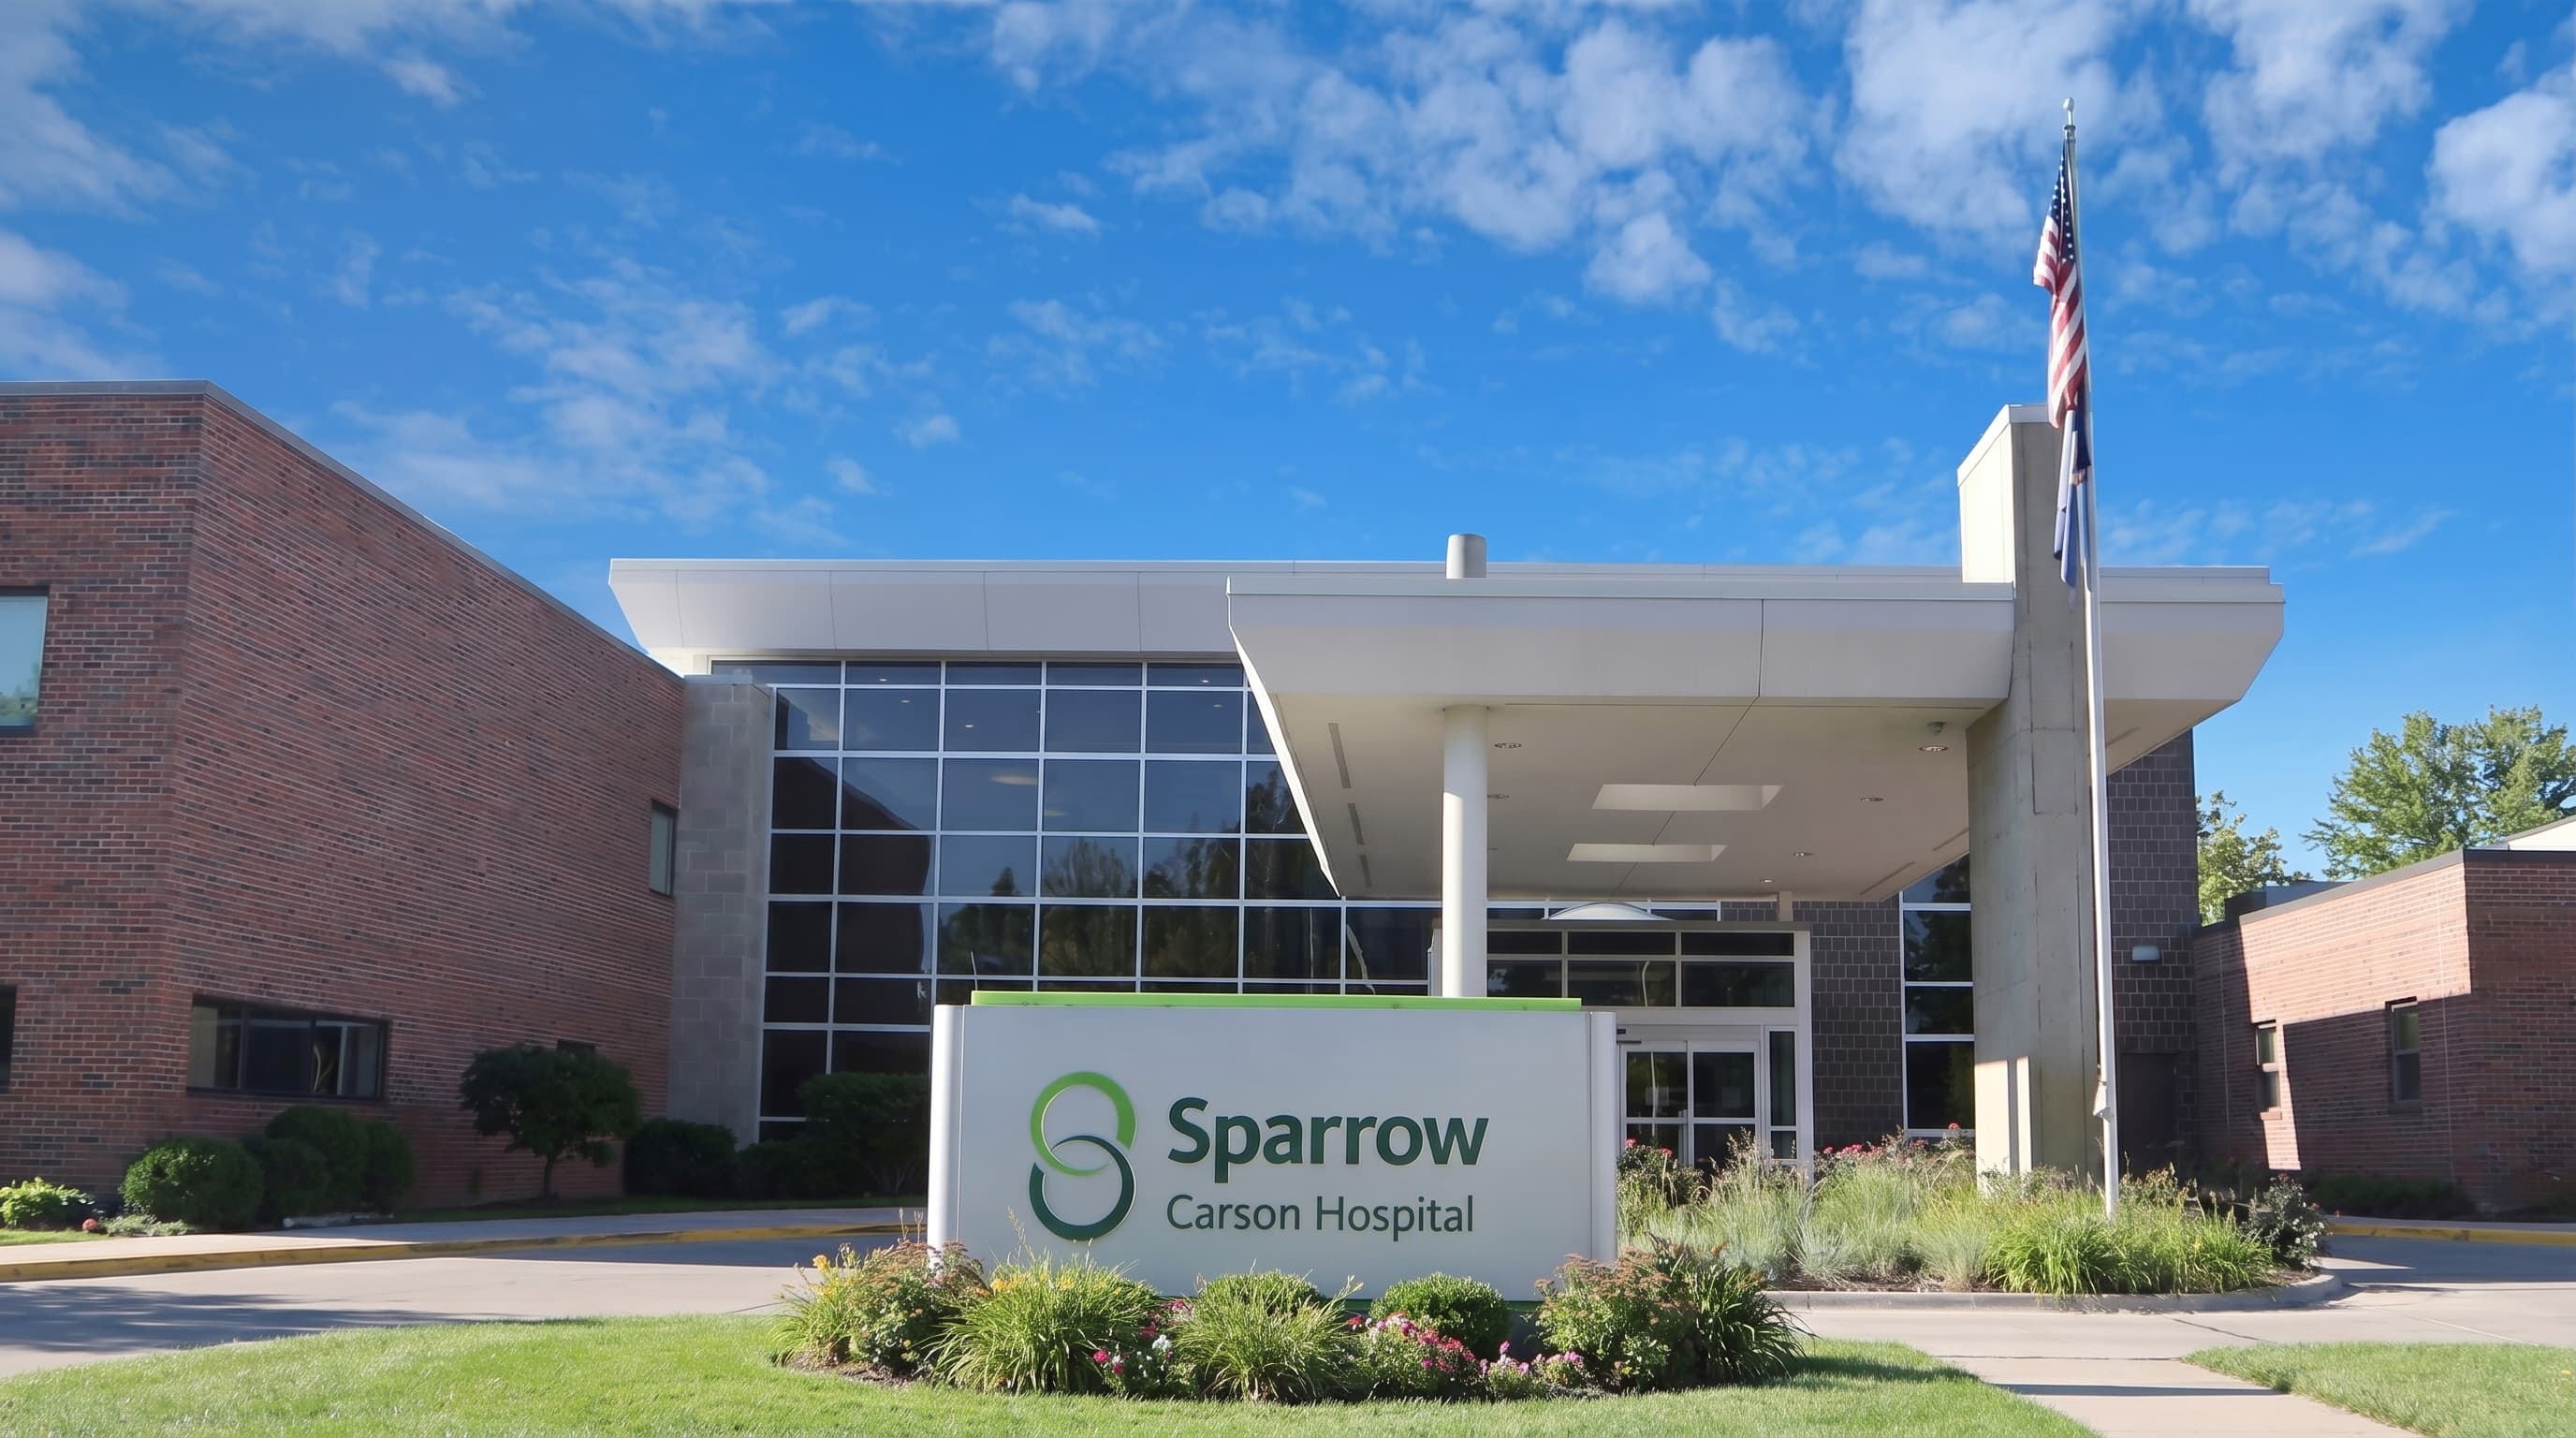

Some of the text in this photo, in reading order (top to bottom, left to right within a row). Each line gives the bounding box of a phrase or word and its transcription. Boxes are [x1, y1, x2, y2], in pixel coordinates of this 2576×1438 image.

[1167, 1096, 1490, 1184] Sparrow
[1166, 1194, 1474, 1242] Carson Hospital
